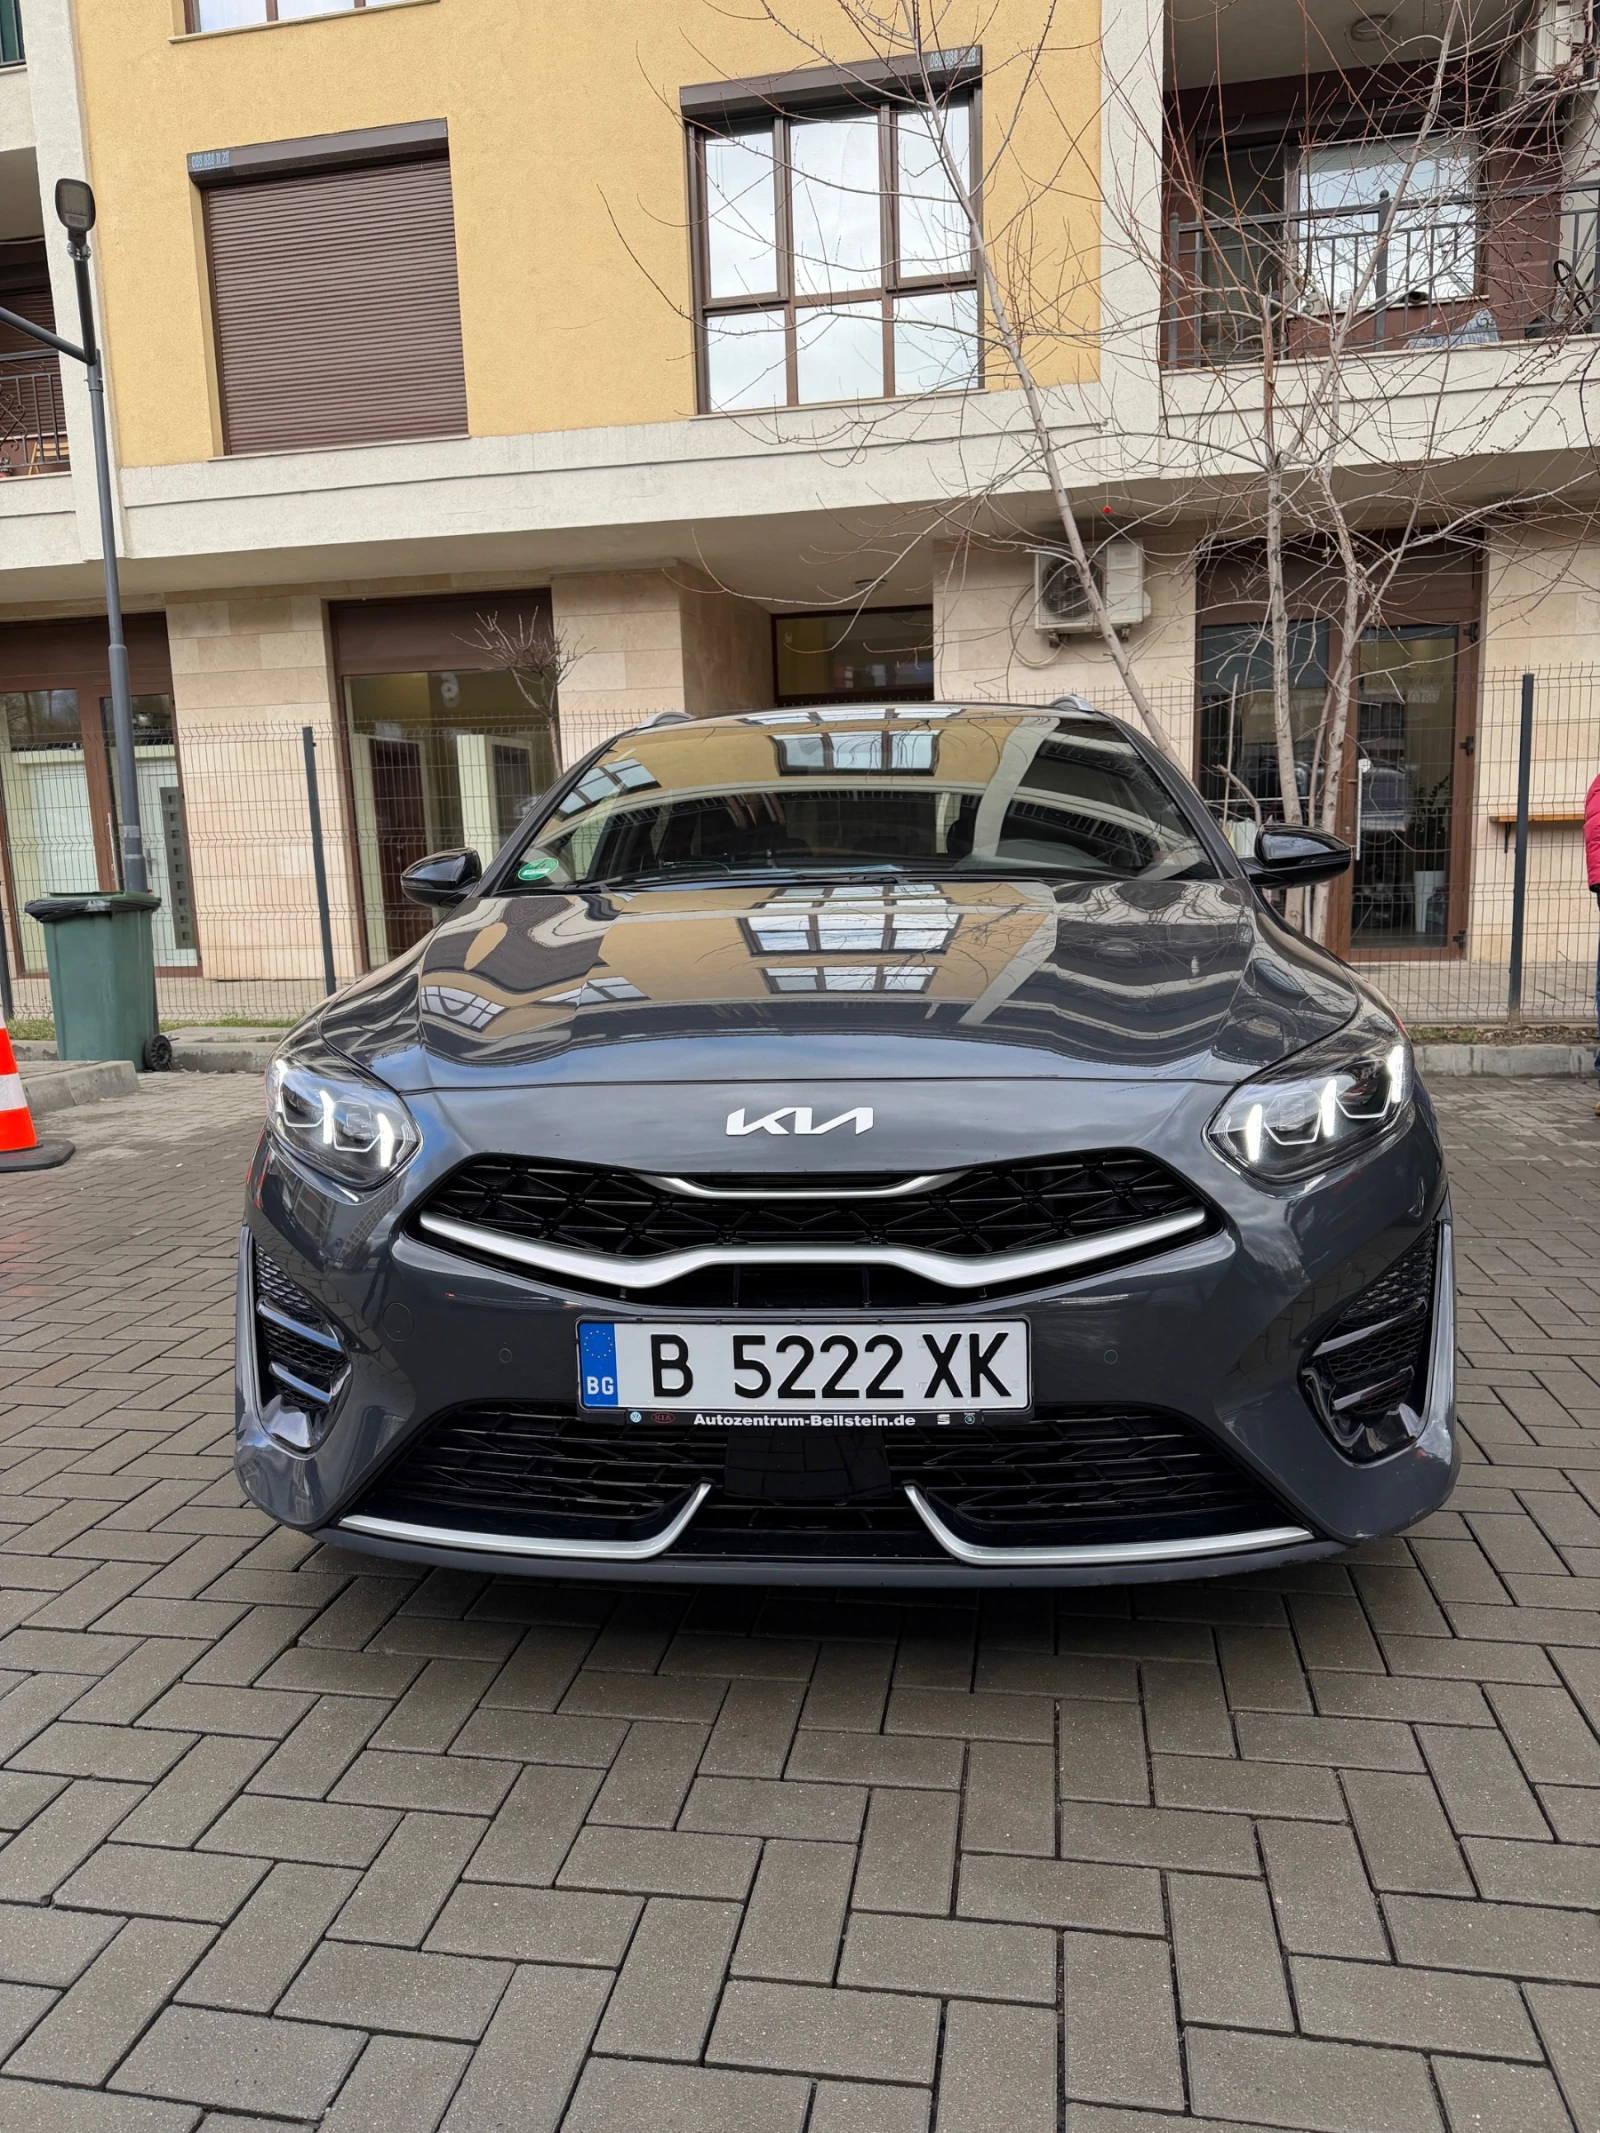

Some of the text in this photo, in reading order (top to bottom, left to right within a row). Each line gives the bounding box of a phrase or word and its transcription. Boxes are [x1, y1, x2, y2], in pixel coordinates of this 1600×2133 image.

[726, 1107, 873, 1136] KIA
[650, 1332, 1012, 1398] B 5222 XK
[586, 1376, 614, 1395] BG
[693, 1413, 916, 1427] Autozentrum-Beilstein.de
